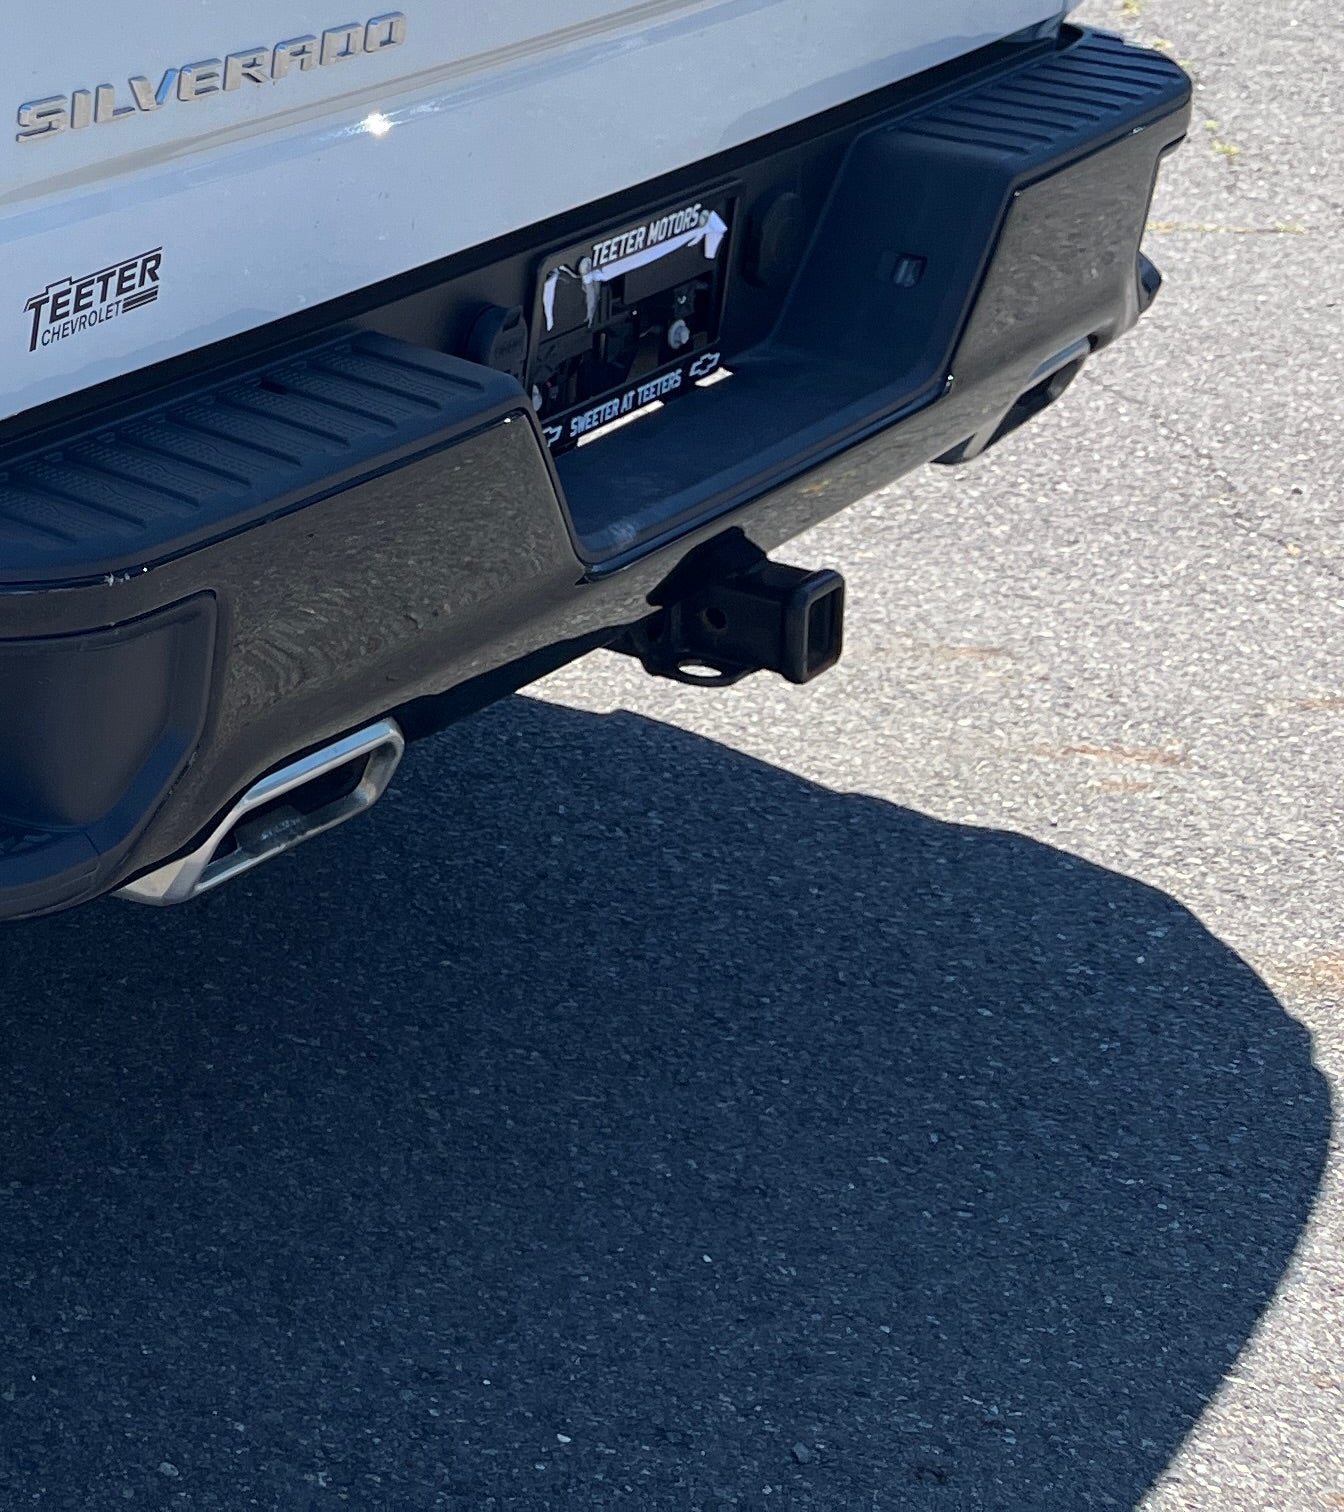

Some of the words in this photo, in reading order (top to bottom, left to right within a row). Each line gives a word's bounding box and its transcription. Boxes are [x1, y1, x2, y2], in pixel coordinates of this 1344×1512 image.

[16, 11, 408, 143] SILVERADO
[592, 226, 644, 267] TEETER
[647, 203, 702, 248] MOTORS
[23, 247, 163, 351] TEETER
[41, 301, 124, 347] CHEVROLET
[569, 400, 619, 438] SWEETER
[621, 393, 635, 413] AT
